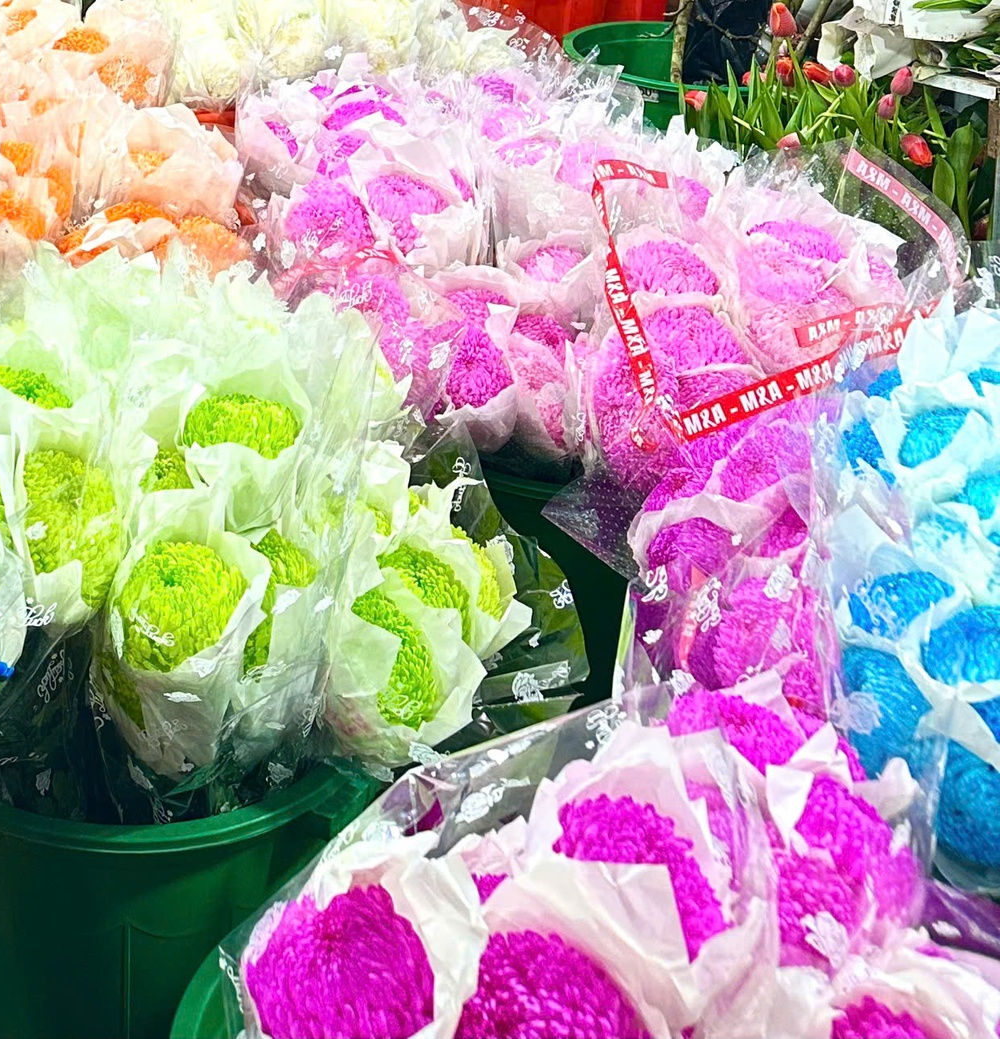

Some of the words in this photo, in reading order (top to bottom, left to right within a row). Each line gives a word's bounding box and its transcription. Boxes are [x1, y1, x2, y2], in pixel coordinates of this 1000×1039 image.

[684, 403, 727, 436] M&A
[739, 383, 783, 412] M&A
[796, 359, 833, 390] M&A
